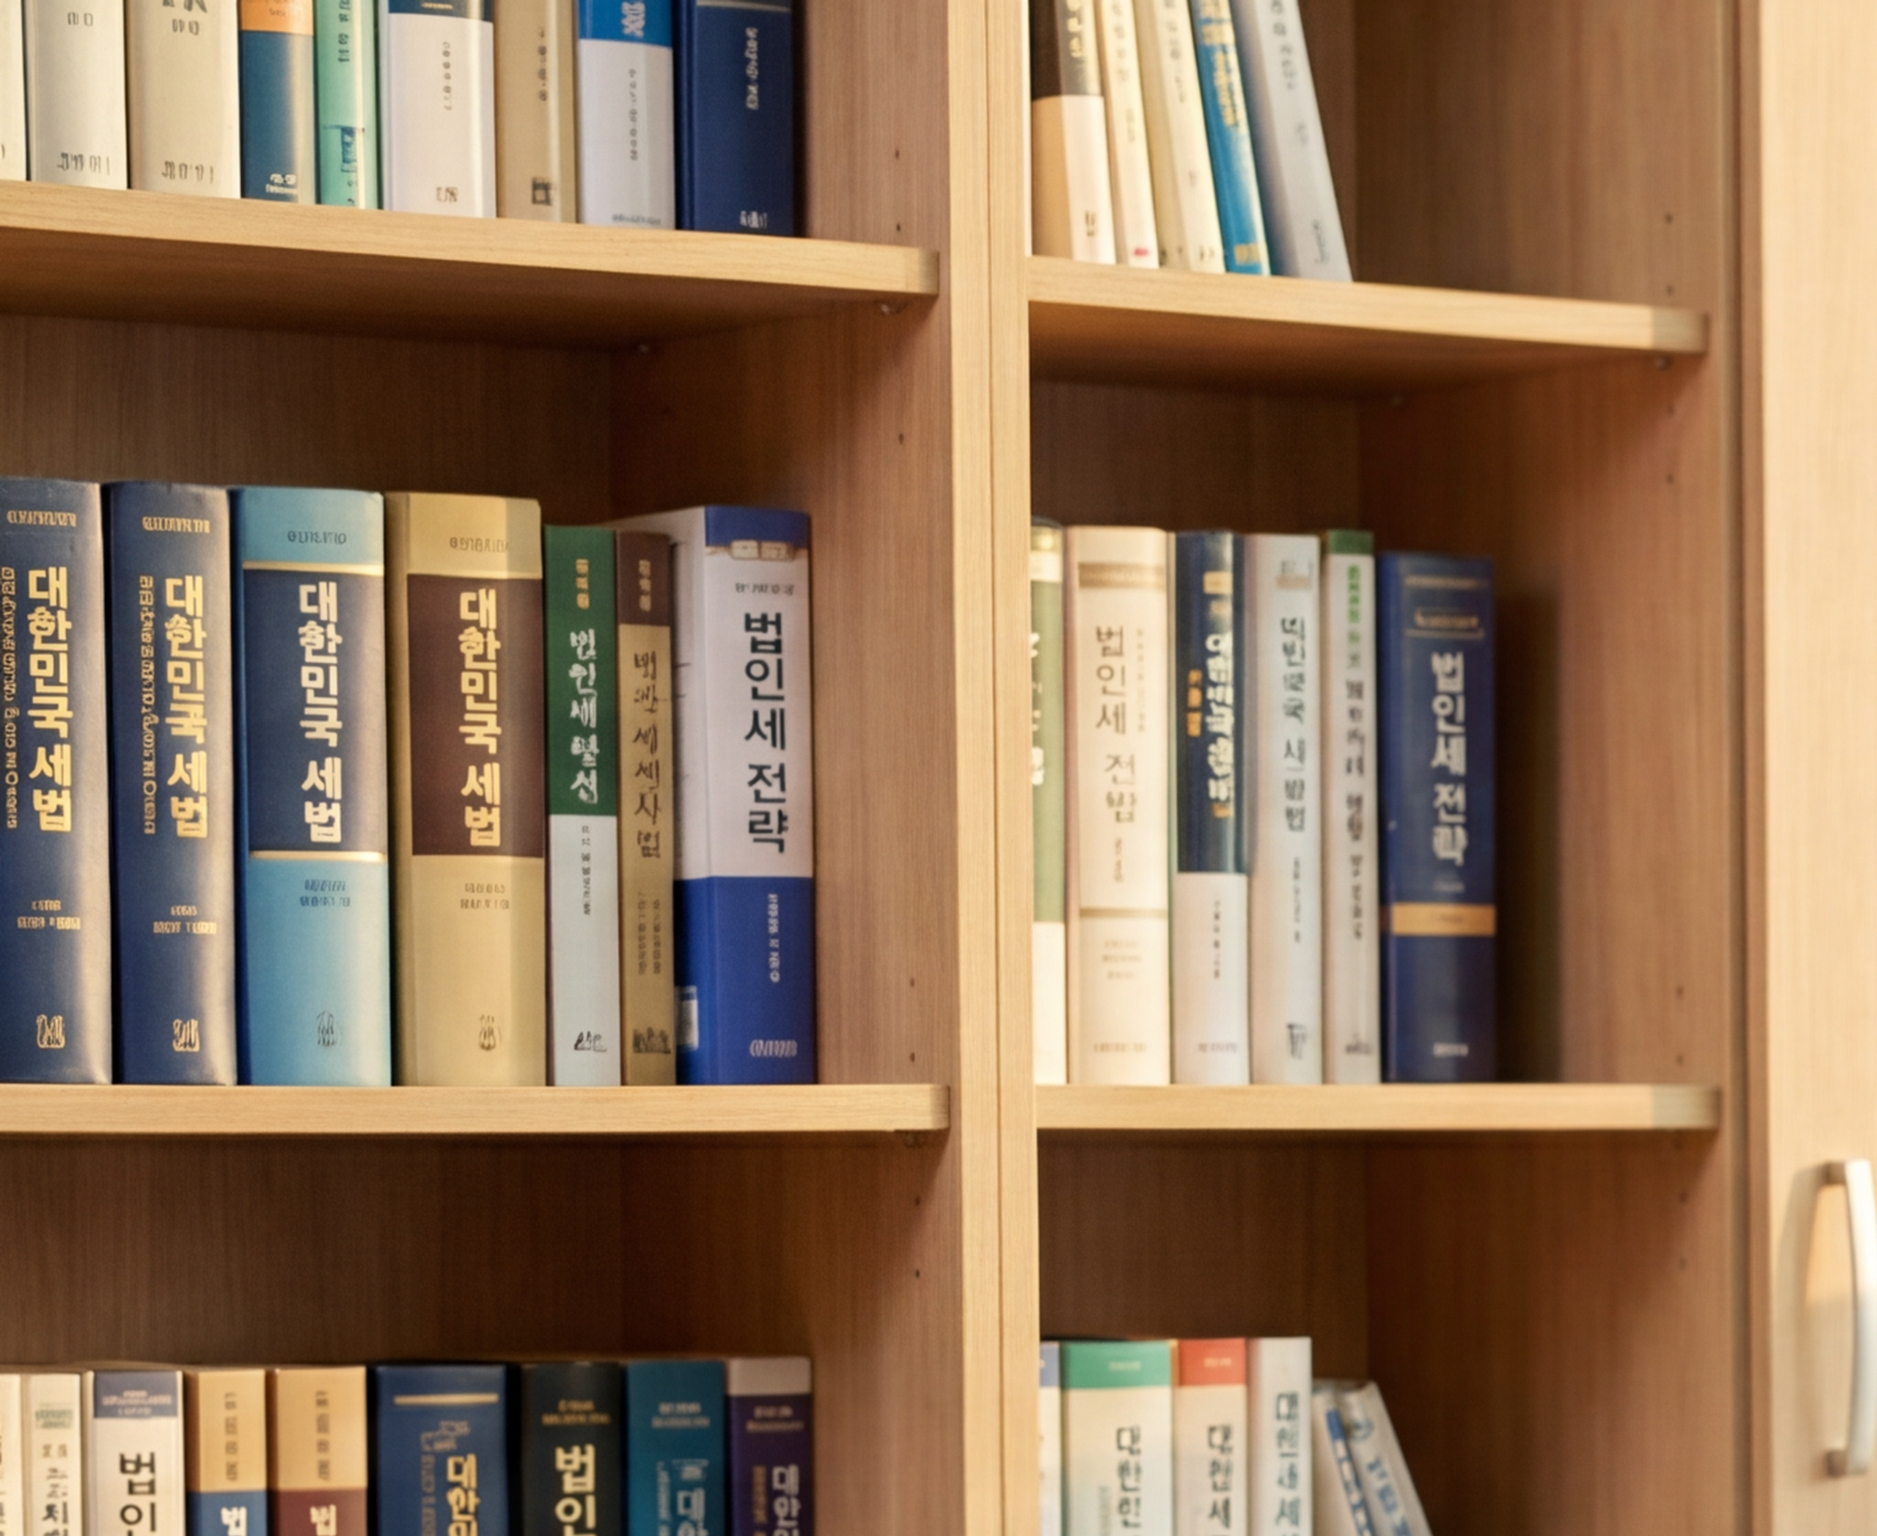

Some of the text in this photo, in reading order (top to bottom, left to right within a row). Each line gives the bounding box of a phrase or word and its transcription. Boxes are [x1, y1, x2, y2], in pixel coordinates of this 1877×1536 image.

[28, 566, 74, 739] 대한민국
[165, 575, 208, 744] 대한민국
[298, 581, 343, 748] 대한민국
[458, 588, 502, 755] 대한민국
[744, 612, 786, 751] 법인세
[1096, 626, 1127, 736] 법인세
[1431, 651, 1468, 777] 법인세
[29, 743, 73, 832] 세법
[167, 750, 208, 838] 세법
[301, 757, 342, 843] 세법
[460, 762, 501, 847] 세법
[747, 763, 789, 853] 전략
